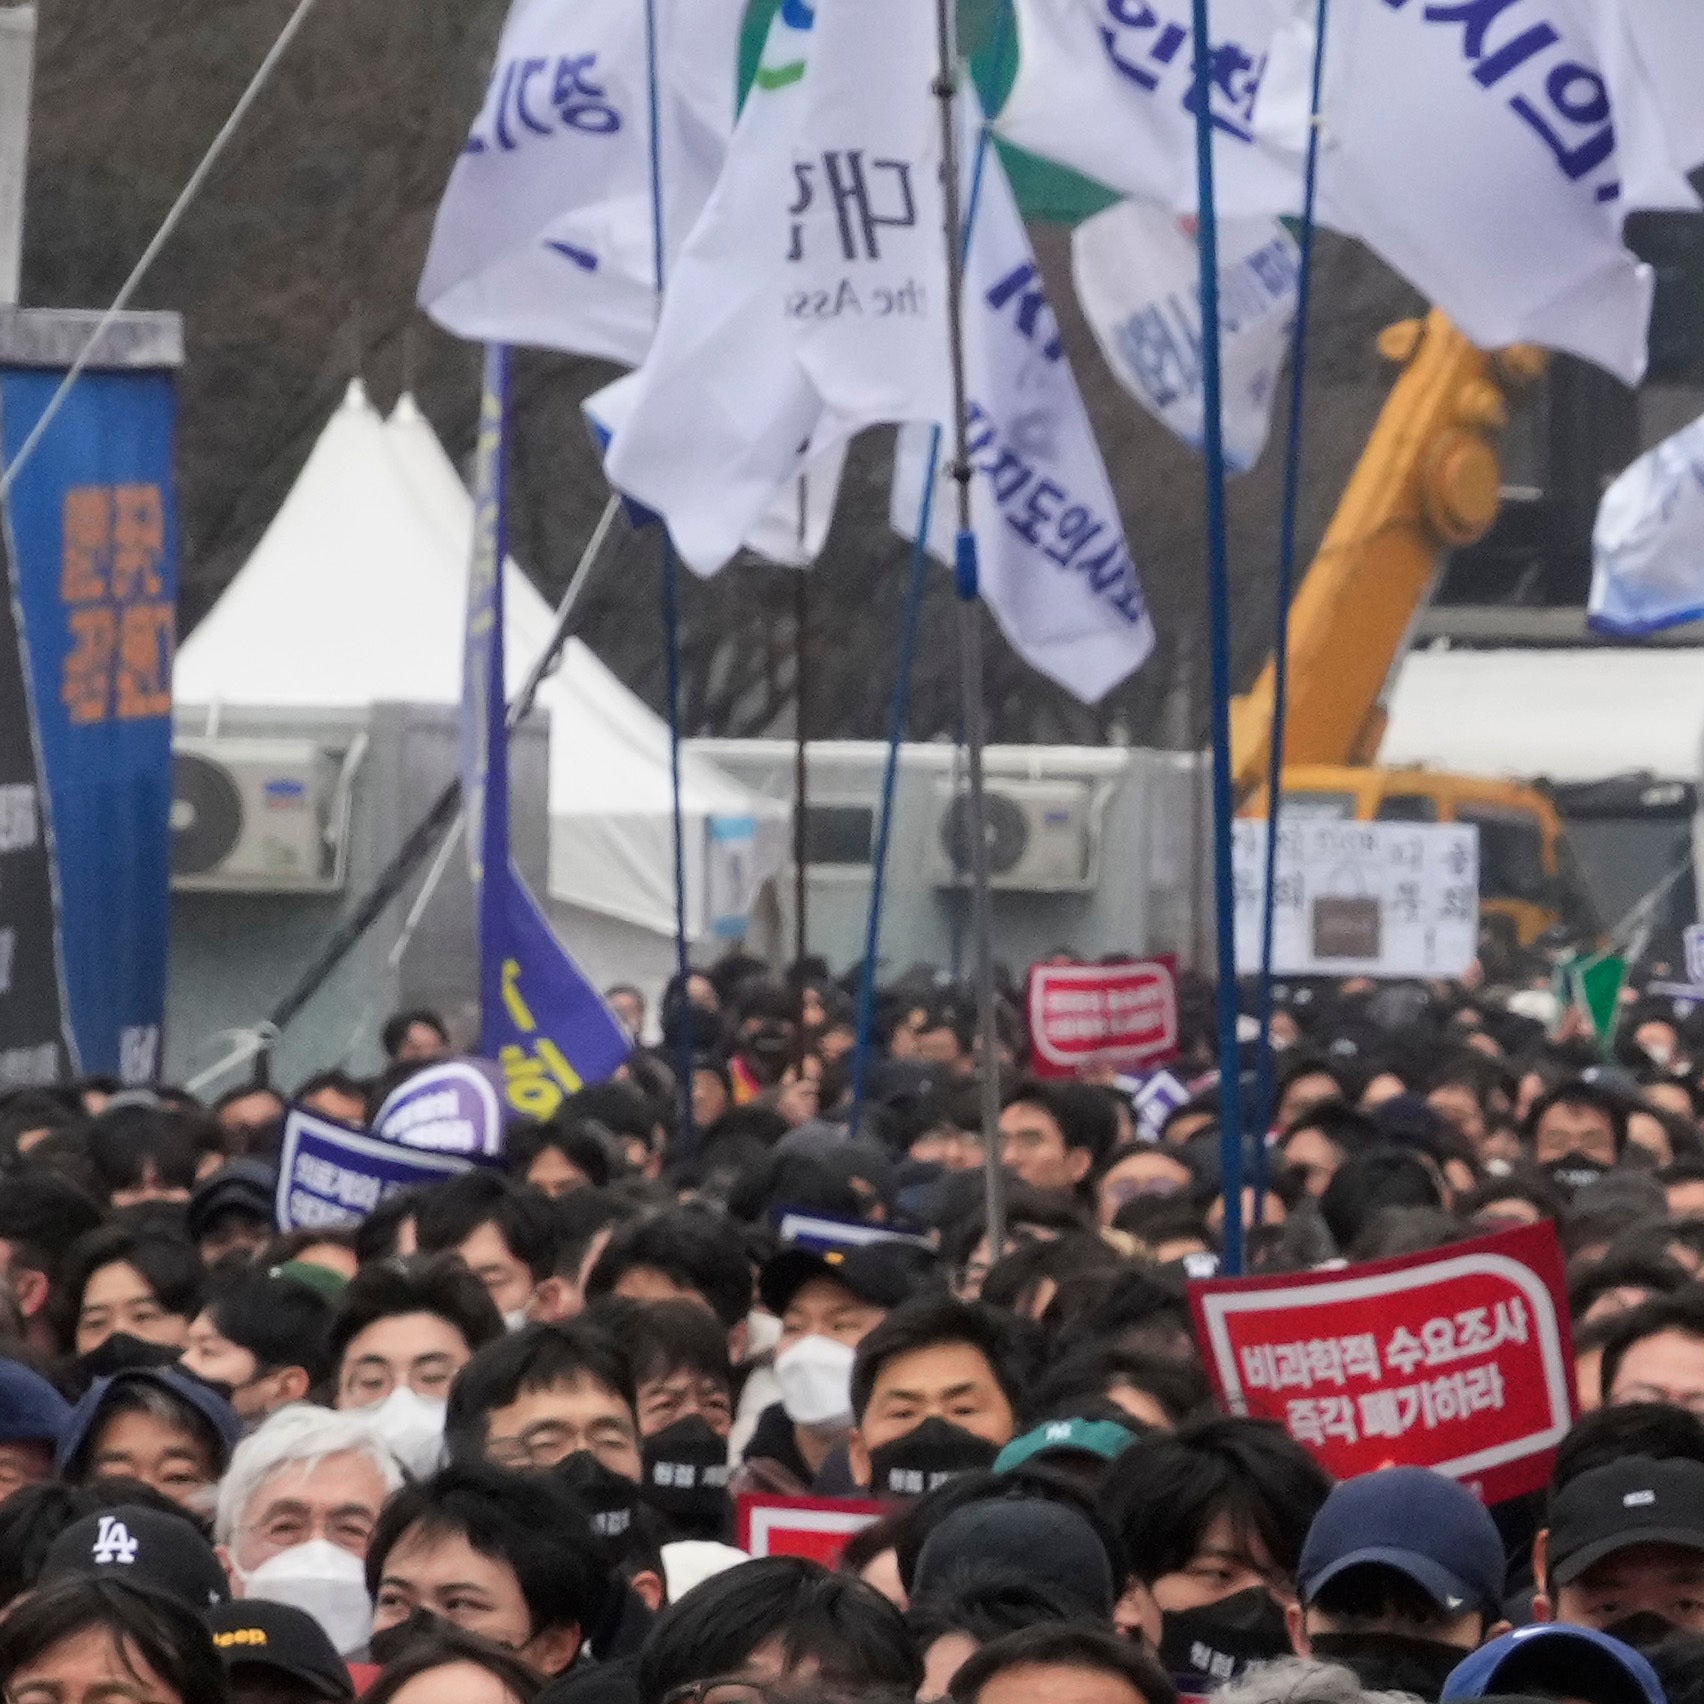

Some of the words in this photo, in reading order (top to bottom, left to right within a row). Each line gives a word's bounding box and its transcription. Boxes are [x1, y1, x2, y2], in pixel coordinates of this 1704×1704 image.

[1242, 1332, 1383, 1396] 비과학적
[1387, 1297, 1528, 1372] 수요조사
[1286, 1388, 1355, 1444] 즉각
[92, 1515, 139, 1564] LA
